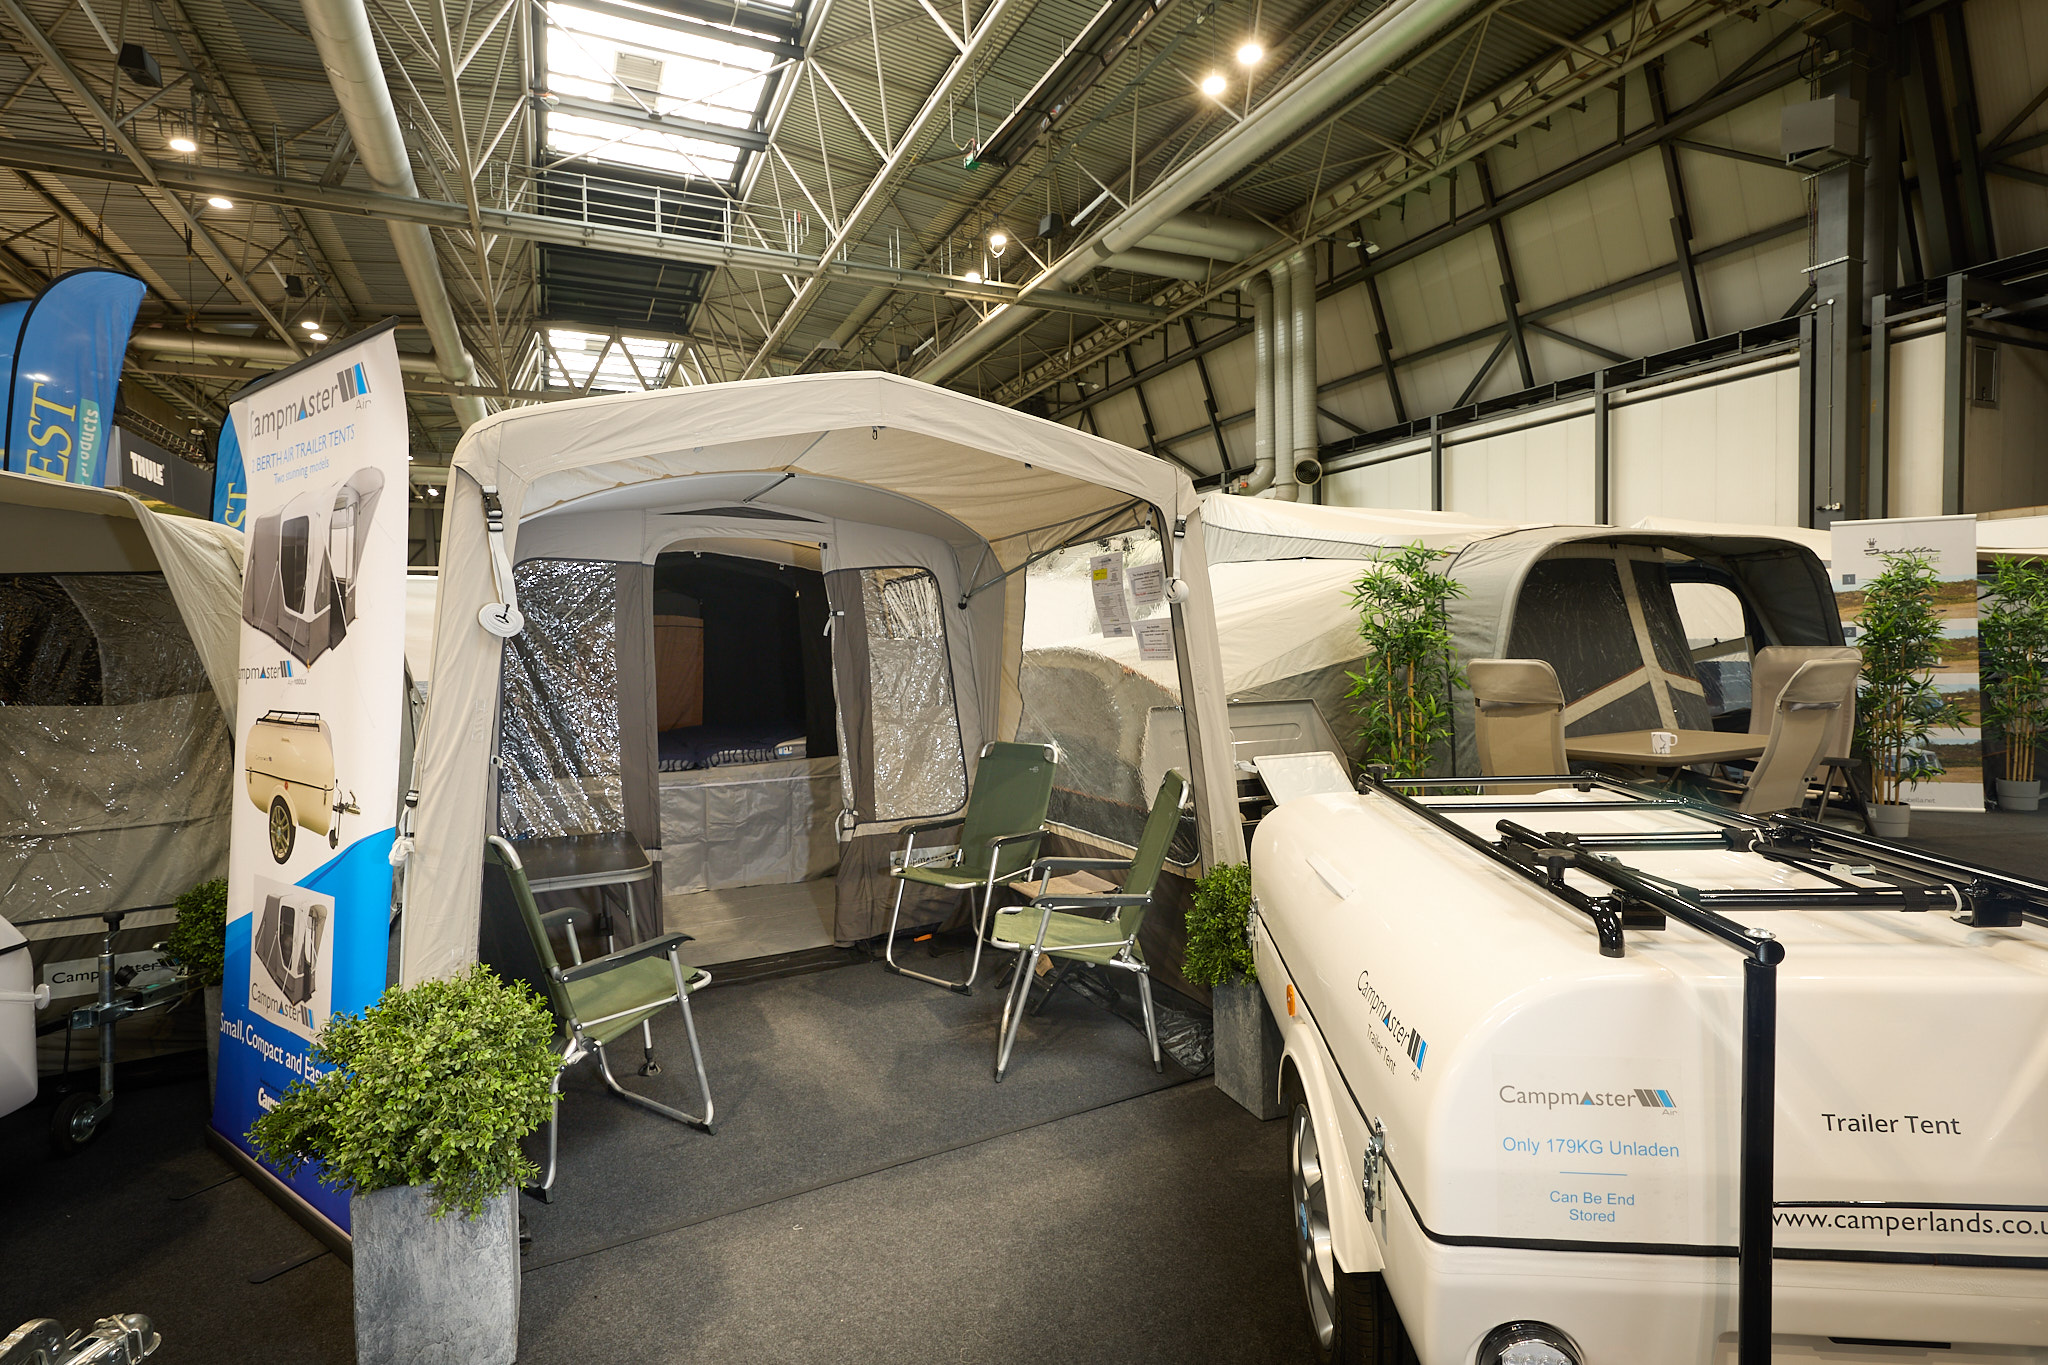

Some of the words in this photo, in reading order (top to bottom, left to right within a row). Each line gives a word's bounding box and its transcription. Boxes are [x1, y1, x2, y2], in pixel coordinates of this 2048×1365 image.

[256, 452, 282, 472] BERTH
[283, 446, 294, 463] AIR
[295, 434, 327, 459] TRAILER
[328, 423, 355, 447] TENTS
[130, 451, 164, 486] THULE
[273, 473, 285, 485] Two
[285, 466, 308, 481] stunning
[309, 456, 329, 473] models
[52, 962, 159, 983] Campter
[220, 1012, 245, 1044] Small,
[246, 1024, 284, 1064] Compact
[285, 1053, 303, 1075] and
[1366, 1023, 1384, 1055] Trailer
[1383, 1046, 1397, 1075] Tent
[1662, 1108, 1678, 1116] Air
[1821, 1113, 1899, 1133] Trailer
[1904, 1115, 1962, 1135] Tent
[1502, 1136, 1540, 1156] Only
[1546, 1138, 1604, 1155] 179KG
[1609, 1140, 1680, 1157] Unladen
[1549, 1190, 1578, 1204] Can
[1583, 1191, 1602, 1205] Be
[1607, 1193, 1635, 1206] End
[1569, 1208, 1616, 1222] Stored
